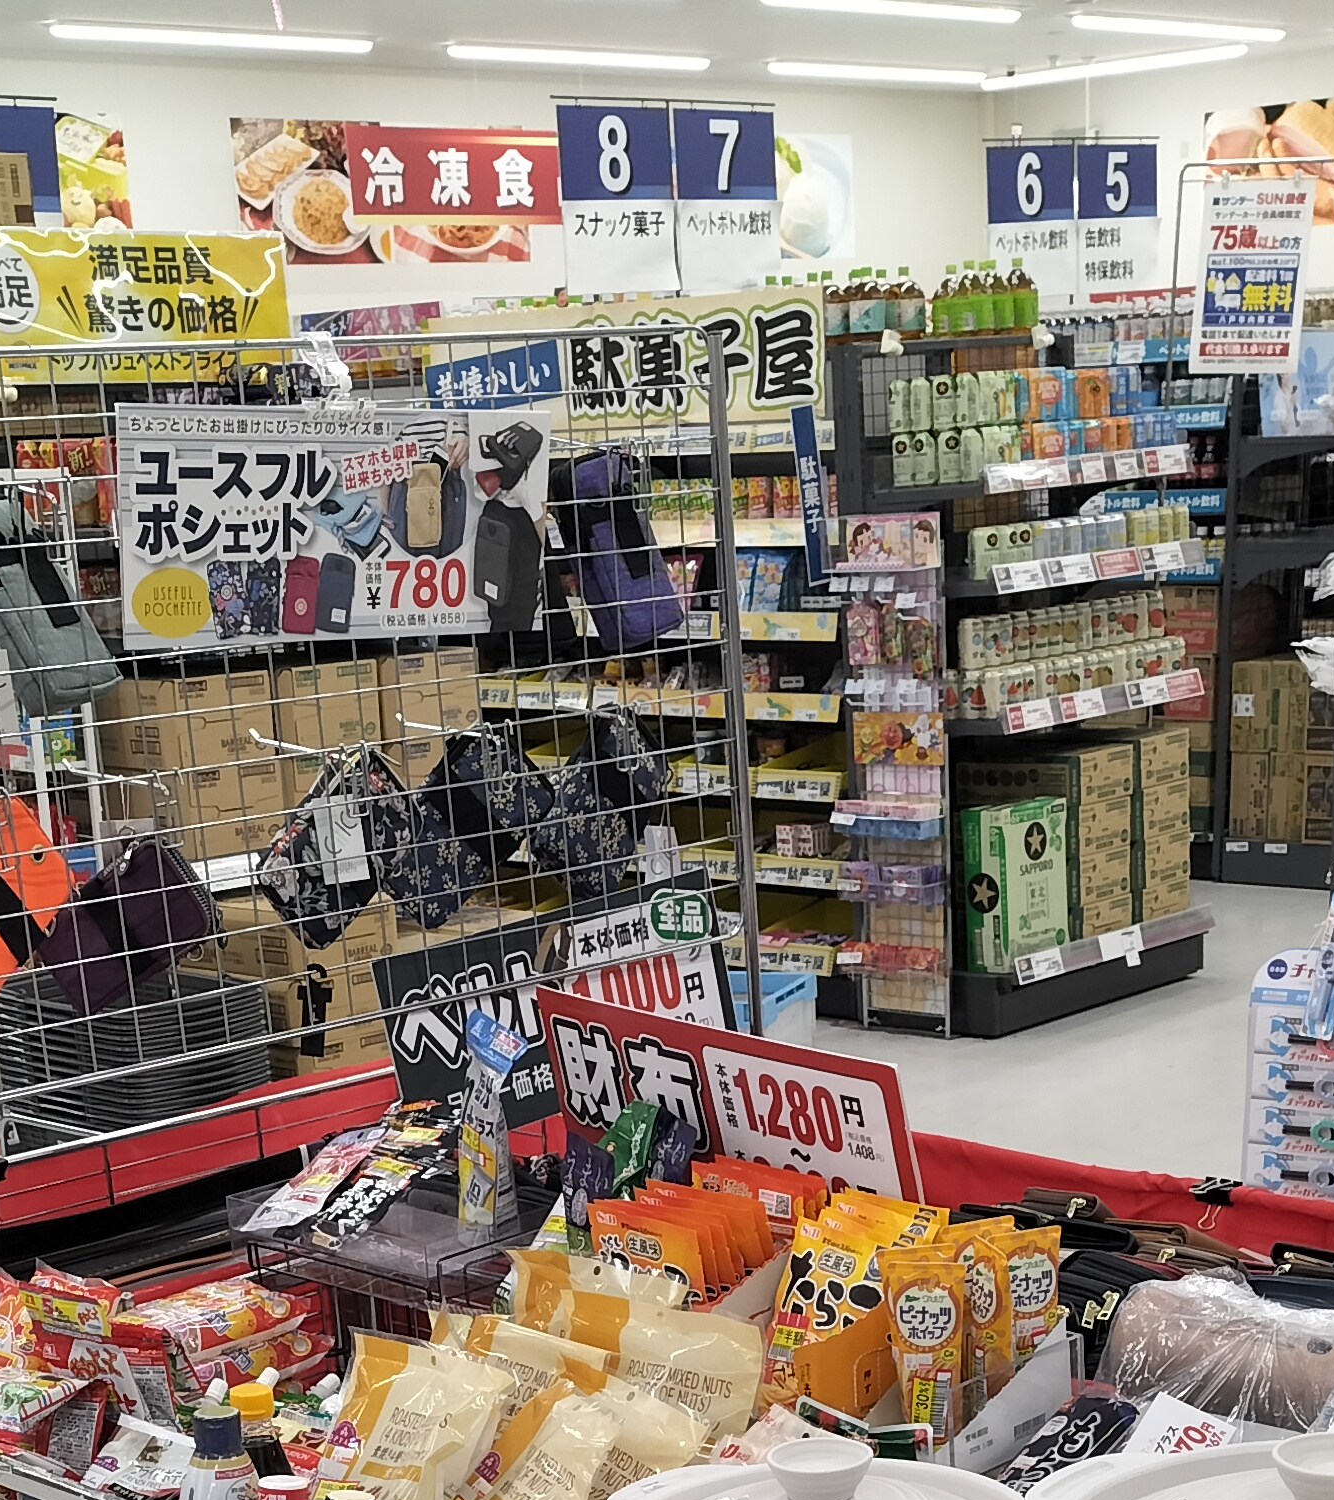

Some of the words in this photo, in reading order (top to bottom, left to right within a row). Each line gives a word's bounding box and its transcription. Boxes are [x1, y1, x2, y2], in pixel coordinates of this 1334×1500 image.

[598, 115, 630, 192] 8
[709, 119, 739, 191] 7
[362, 147, 535, 207] 冷凍食
[1017, 152, 1043, 215] 6
[1106, 152, 1129, 212] 5
[575, 211, 664, 237] スナック菓子
[688, 211, 772, 236] ペットボトル飲料
[996, 229, 1067, 253] ペットボトル飲料
[1085, 227, 1121, 248] 缶飲料
[1210, 225, 1302, 250] 75歳以上の方
[89, 245, 214, 284] 満足品質
[1242, 283, 1292, 311] 無料
[86, 297, 238, 333] 驚きの価格
[572, 310, 816, 410] 駄菓子屋
[136, 450, 330, 499] ユースフル
[343, 442, 418, 472] スマホも収納
[344, 465, 412, 490] 出来ちゃう!
[799, 456, 823, 533] 駄菓子
[135, 503, 306, 555] ポシェット
[145, 601, 202, 617] POCHETTE
[153, 586, 193, 600] USEFUL
[654, 899, 705, 935] 全品
[578, 917, 649, 957] 本体価格
[552, 1015, 709, 1151] 財布
[714, 1061, 740, 1128] 本体価格
[733, 1068, 865, 1153] 1,280円
[627, 1235, 660, 1257] 生風味
[820, 1253, 854, 1276] 生風味
[1013, 1288, 1051, 1307] ホイップ
[898, 1305, 951, 1326] ピーナッツ
[907, 1323, 948, 1341] ホイップ
[668, 1365, 701, 1392] MIXED
[702, 1375, 733, 1400] NUTS
